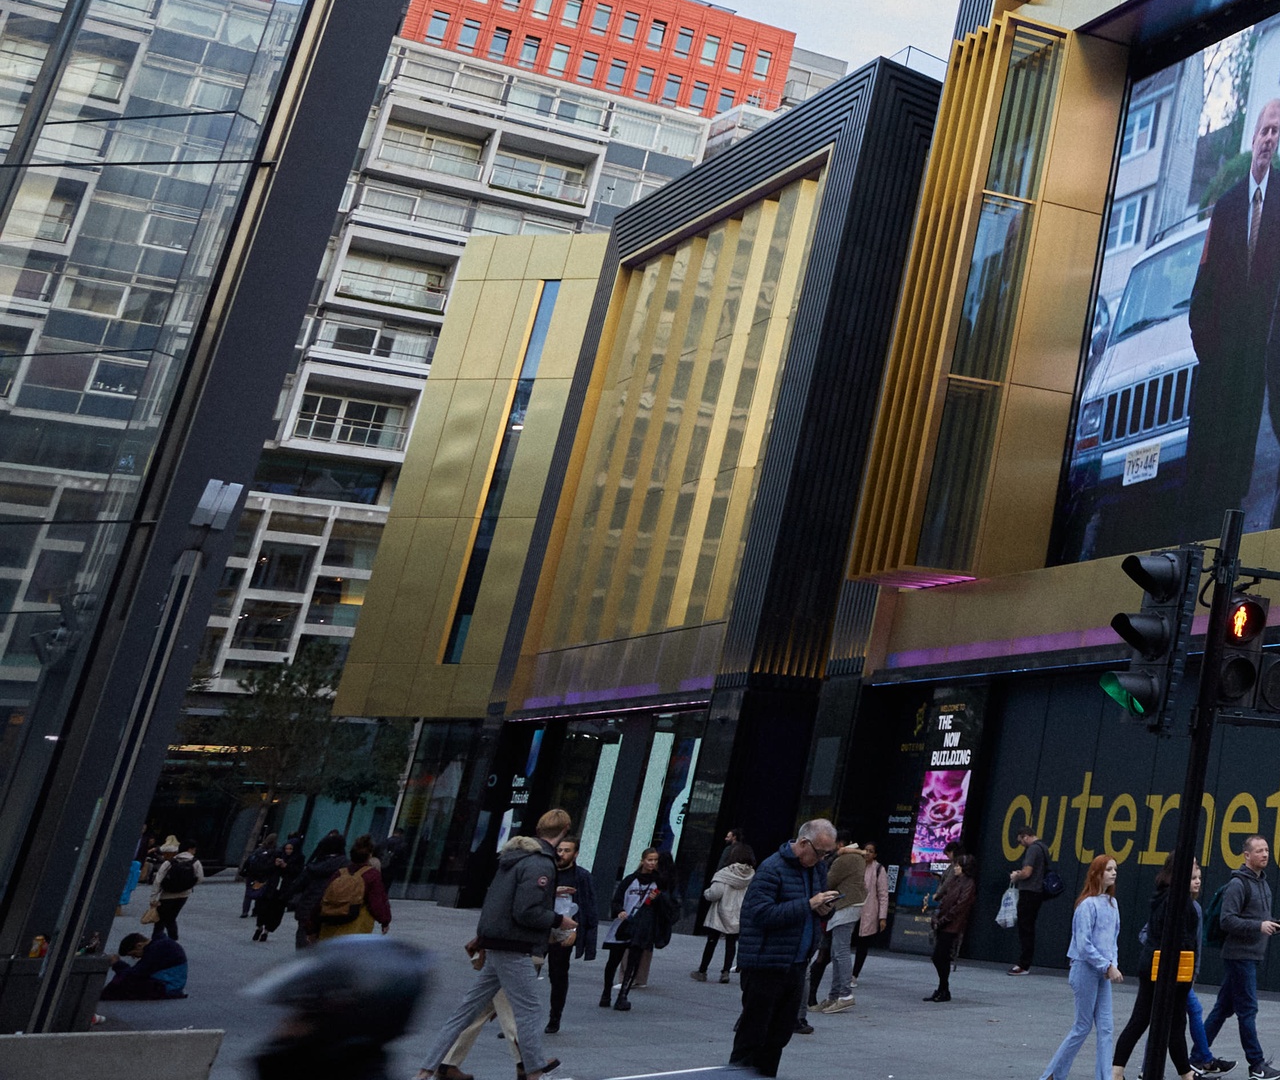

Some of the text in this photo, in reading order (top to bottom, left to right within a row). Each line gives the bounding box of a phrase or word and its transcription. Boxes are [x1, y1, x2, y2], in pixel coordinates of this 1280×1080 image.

[938, 714, 954, 730] THE
[943, 731, 961, 748] NOW
[930, 749, 972, 766] BUILDING
